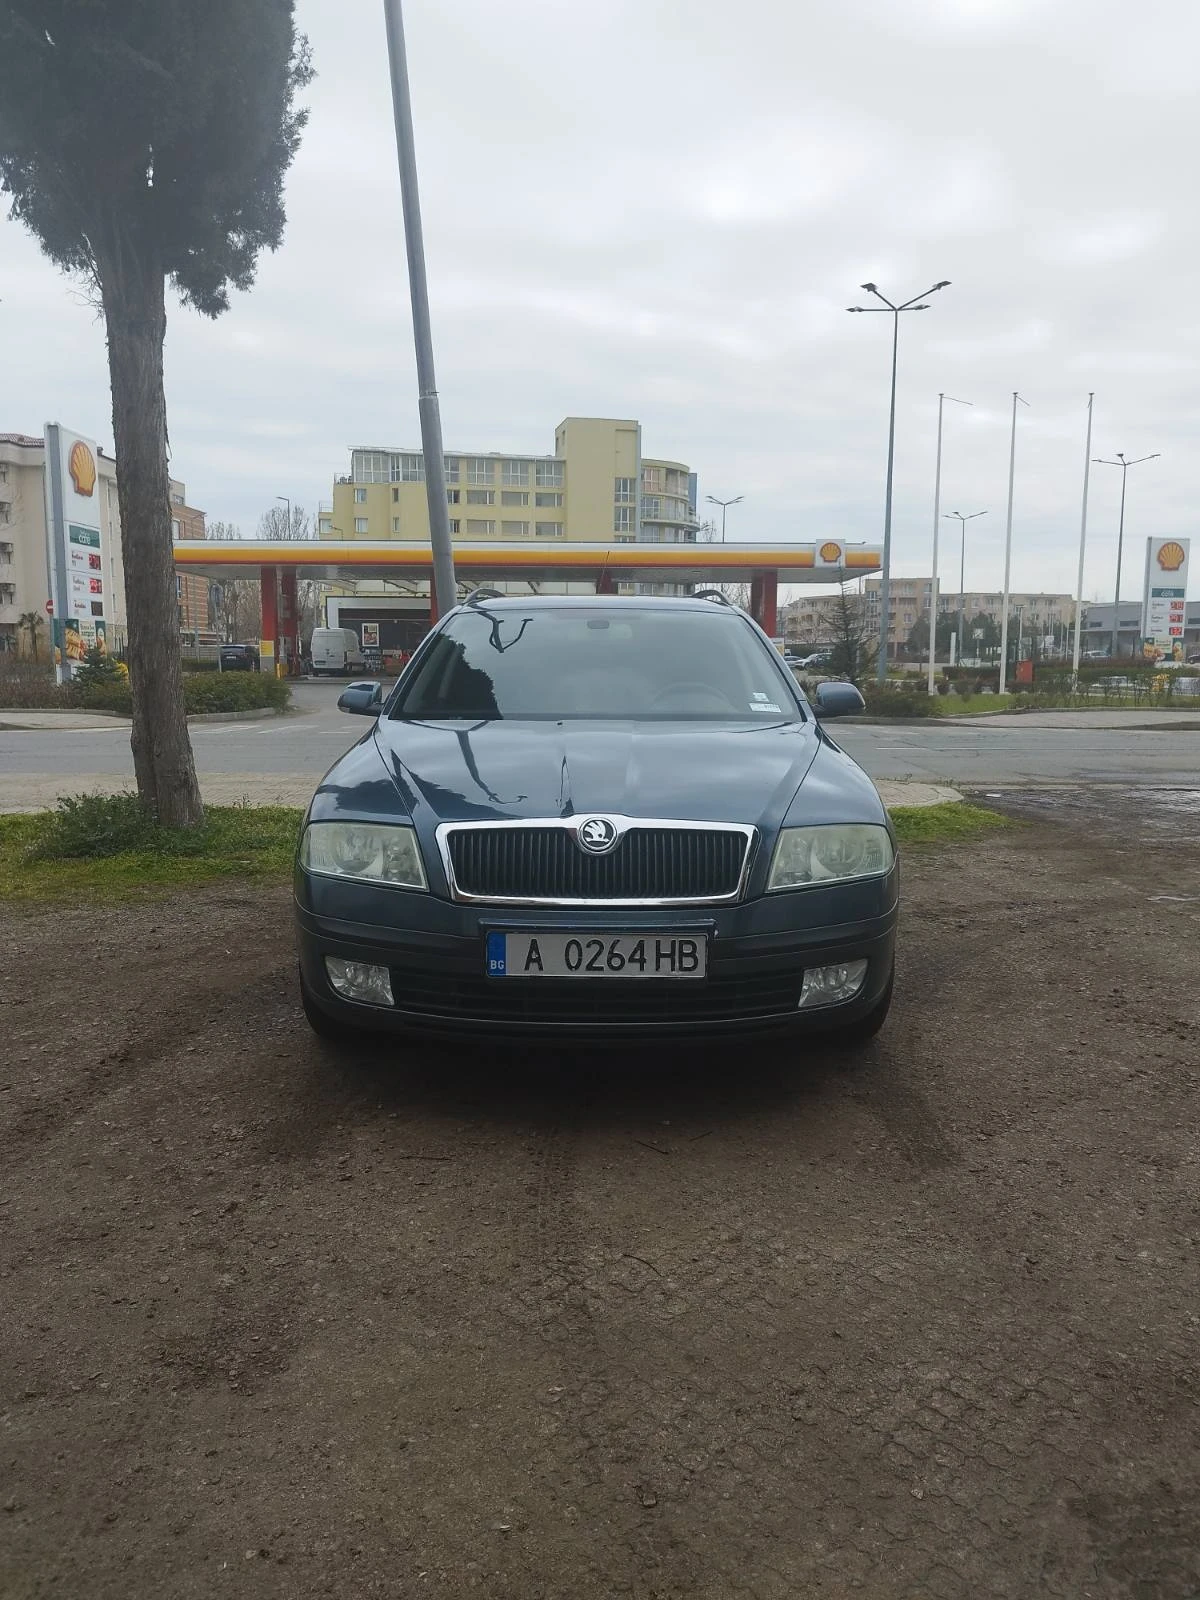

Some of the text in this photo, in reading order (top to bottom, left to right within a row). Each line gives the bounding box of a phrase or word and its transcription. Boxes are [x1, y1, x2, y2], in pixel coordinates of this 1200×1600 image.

[490, 960, 505, 970] BG
[524, 938, 544, 972] A
[564, 938, 647, 973] 0264
